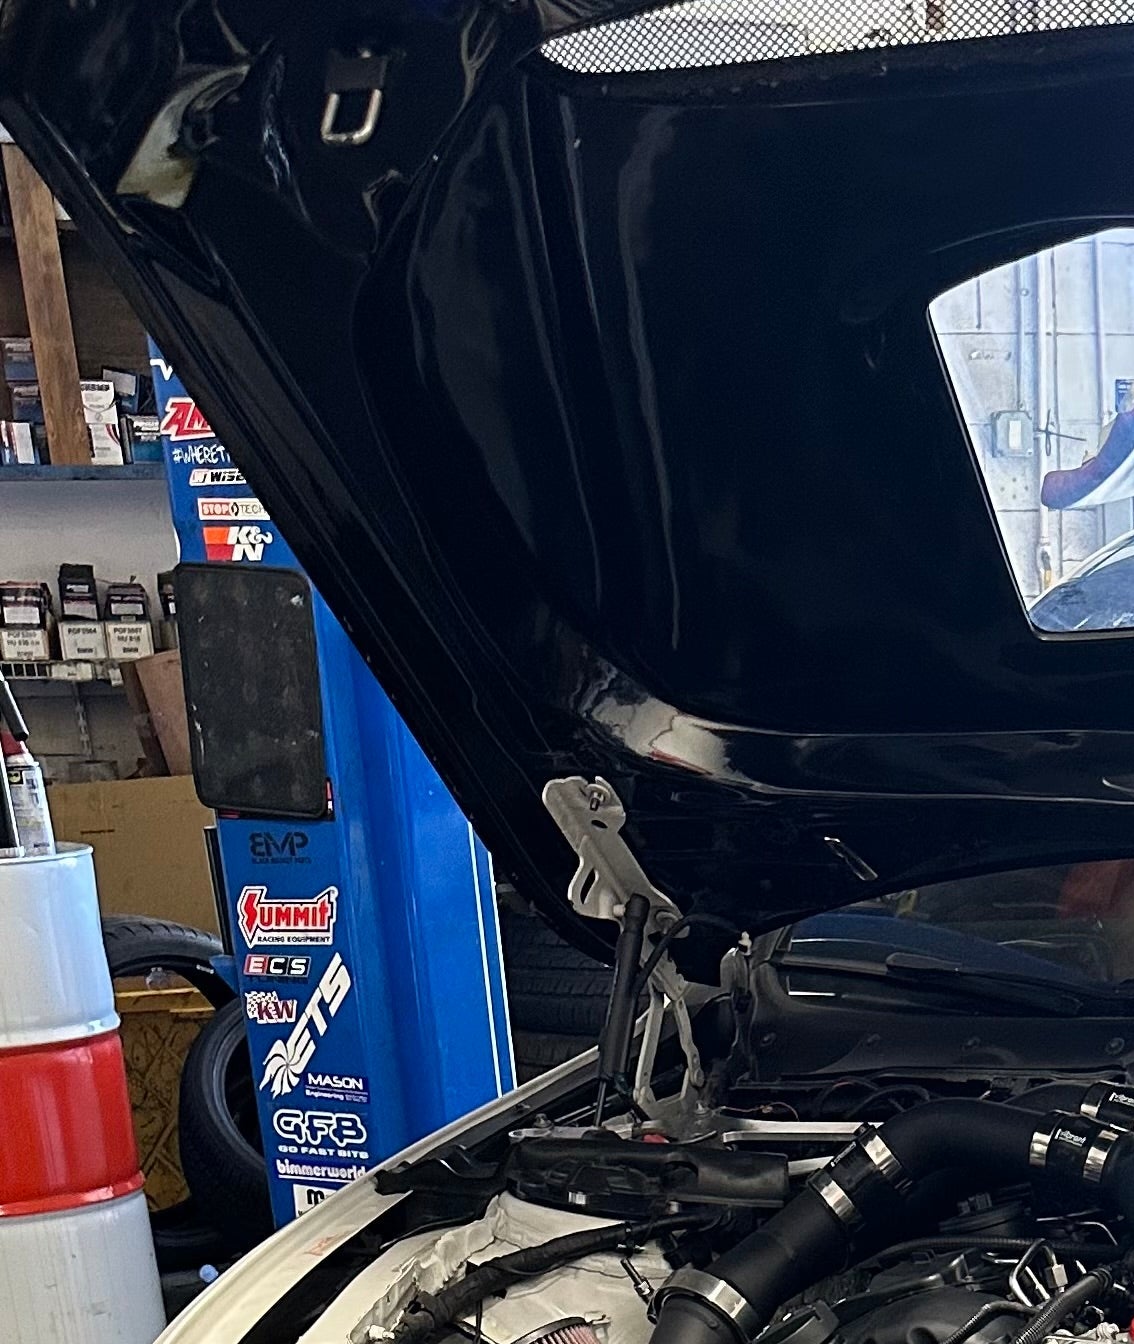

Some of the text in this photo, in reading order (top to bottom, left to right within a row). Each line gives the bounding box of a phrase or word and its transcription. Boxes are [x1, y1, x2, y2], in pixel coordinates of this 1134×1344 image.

[202, 502, 230, 515] STOP
[248, 957, 307, 975] ECS
[307, 1072, 364, 1091] MASON
[273, 1109, 368, 1147] GFB
[278, 1145, 370, 1160] GO FAST BITS
[275, 1158, 367, 1180] bimmerworld
